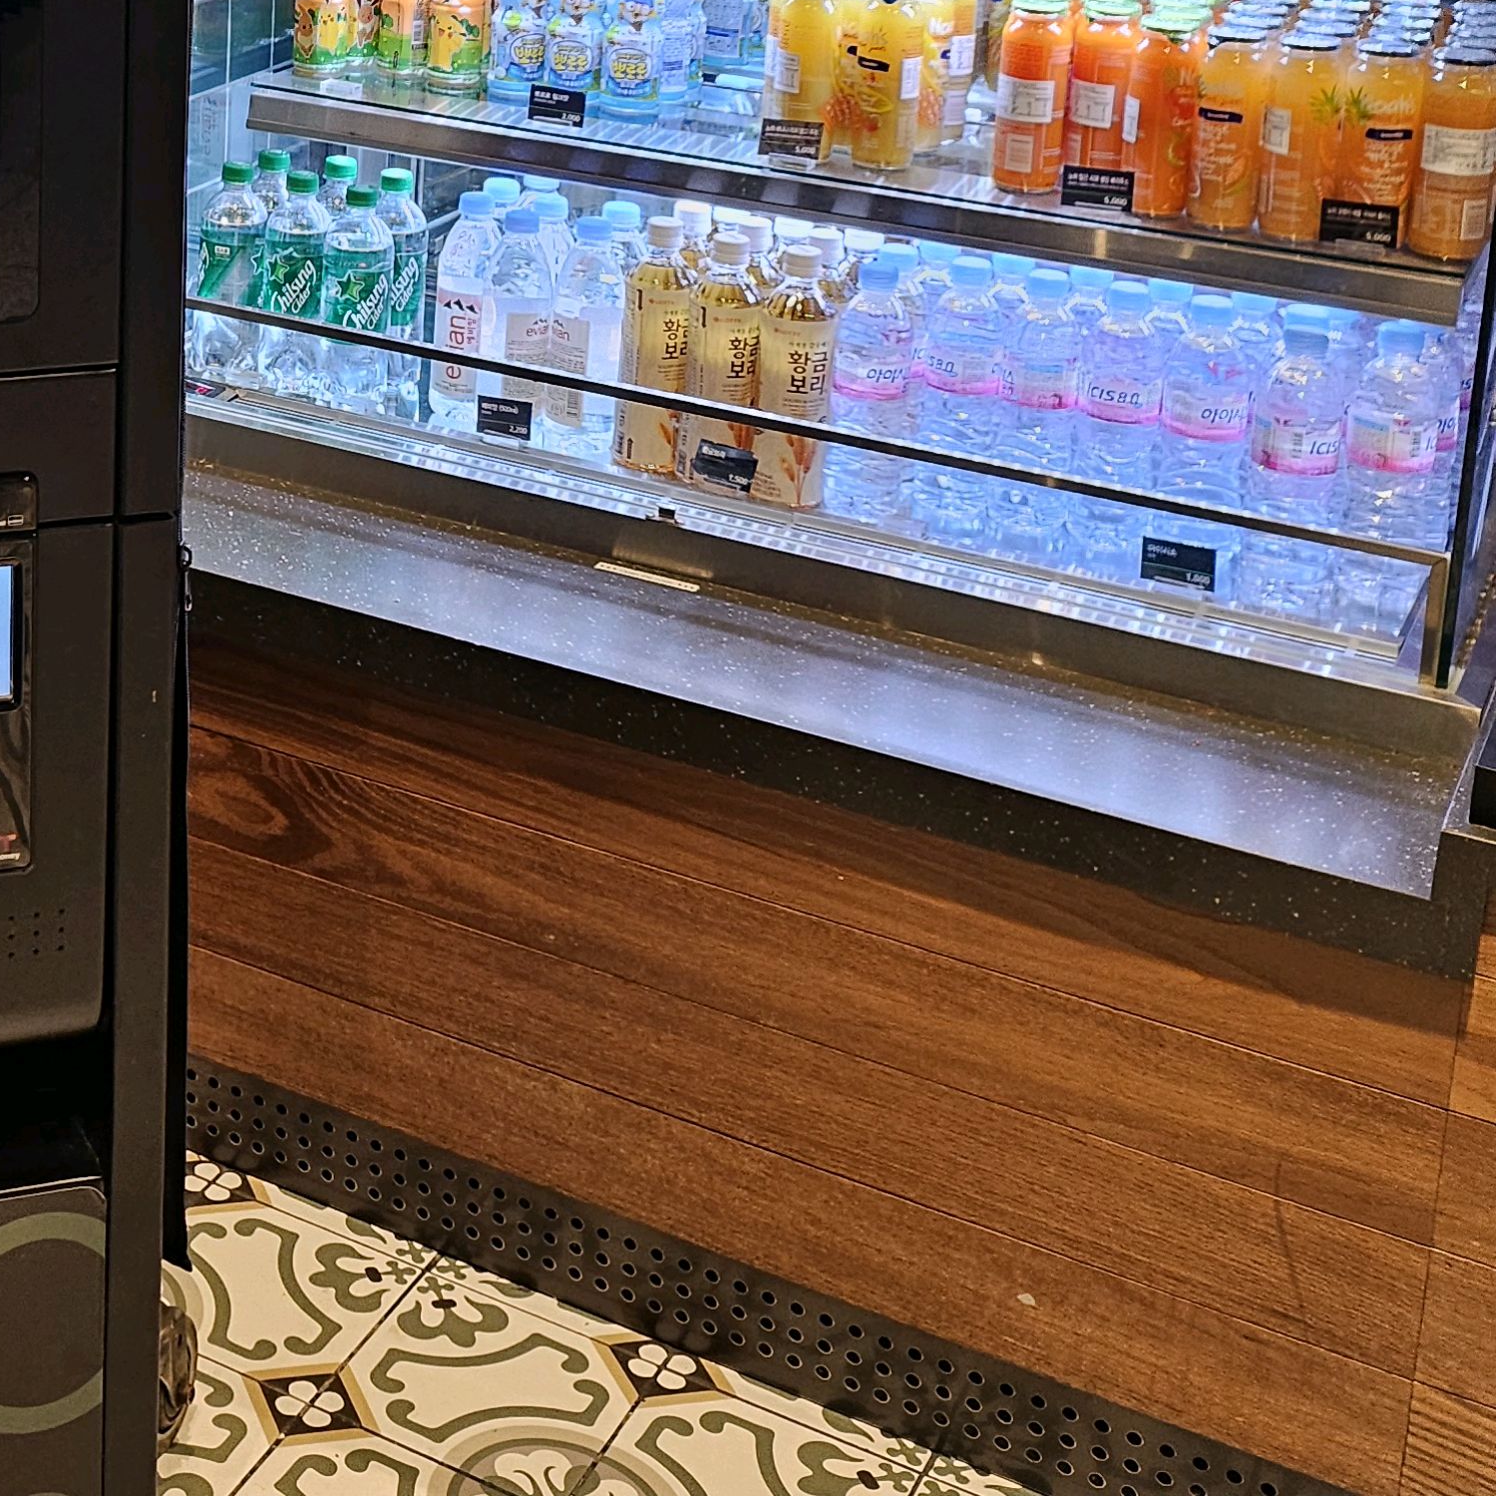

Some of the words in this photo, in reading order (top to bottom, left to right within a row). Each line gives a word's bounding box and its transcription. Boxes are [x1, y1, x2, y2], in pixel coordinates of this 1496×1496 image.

[445, 314, 466, 380] eian
[787, 350, 828, 375] 황금
[786, 374, 826, 395] 보리
